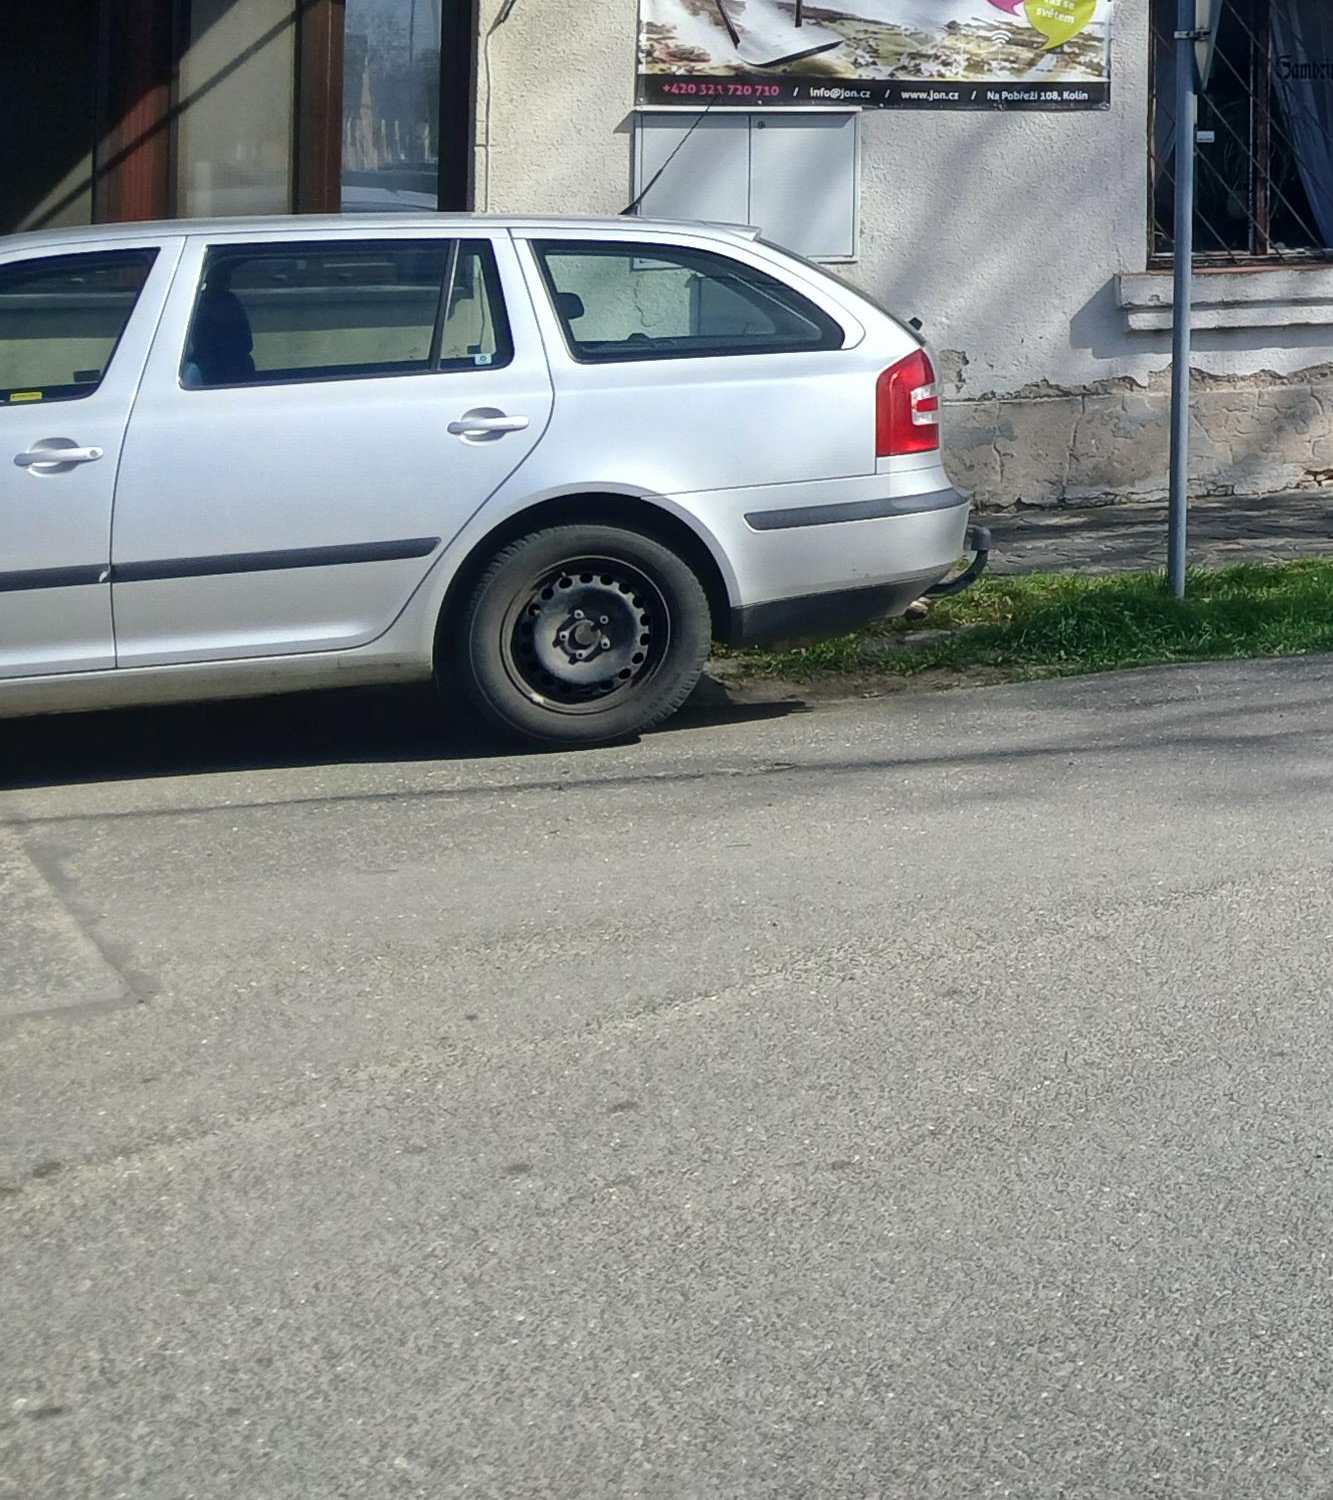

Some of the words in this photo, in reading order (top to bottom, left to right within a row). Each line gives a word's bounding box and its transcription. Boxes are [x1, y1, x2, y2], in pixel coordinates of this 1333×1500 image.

[1062, 0, 1076, 10] se
[662, 83, 697, 94] +420
[727, 84, 753, 96] 720
[754, 85, 780, 97] 710
[809, 86, 871, 99] info@jon.cz
[901, 89, 960, 101] www.jon.cz
[986, 90, 1000, 101] Na
